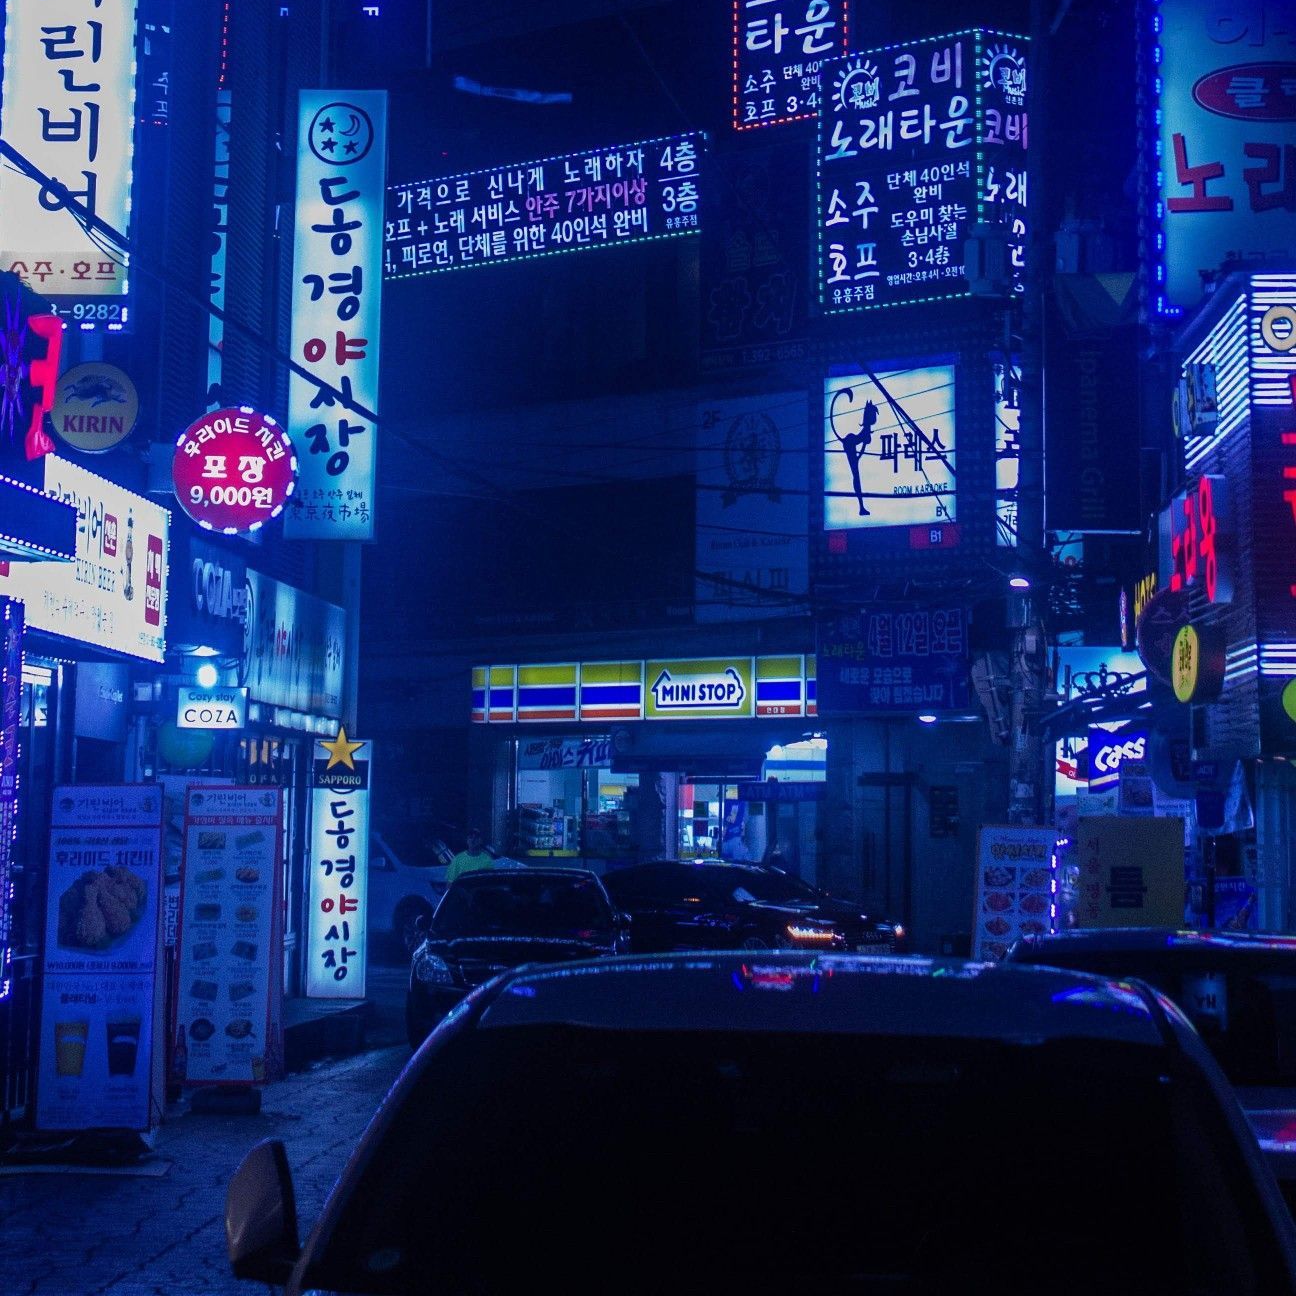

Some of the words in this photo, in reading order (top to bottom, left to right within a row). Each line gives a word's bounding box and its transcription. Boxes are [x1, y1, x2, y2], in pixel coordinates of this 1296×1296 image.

[745, 0, 836, 54] 타운
[744, 69, 776, 93] 소주
[783, 62, 803, 80] 단체
[801, 75, 821, 90] 완비
[888, 41, 962, 101] 코비
[743, 99, 776, 122] 호프
[824, 95, 975, 161] 노래타운
[982, 108, 1028, 150] 코비
[660, 141, 697, 173] 4층
[397, 179, 471, 215] 가격으로
[487, 166, 545, 199] 신나게
[563, 148, 645, 184] 노래하자
[886, 169, 917, 190] 단체
[920, 160, 970, 183] 40인석
[662, 181, 699, 213] 3층
[825, 181, 879, 230] 소주
[913, 184, 942, 204] 완비
[433, 211, 466, 236] 노래
[470, 200, 521, 229] 서비스
[525, 194, 560, 222] 안주
[890, 207, 933, 228] 도우미
[458, 230, 507, 260] 단체를
[513, 222, 547, 252] 위한
[551, 213, 607, 245] 40인석
[613, 206, 648, 237] 완비
[826, 242, 880, 284] 호프
[832, 284, 875, 304] 유흥주점
[302, 176, 370, 477] 동경야시장
[62, 414, 125, 434] KIRIN
[183, 417, 250, 458] 후라이드
[254, 426, 286, 462] 치킨
[201, 455, 267, 483] 포장
[190, 485, 272, 508] 9,000원
[930, 530, 943, 543] B1
[188, 691, 214, 703] Cozy
[216, 691, 236, 703] stay
[661, 682, 737, 703] MINISTOP
[184, 709, 238, 724] COZA
[1094, 737, 1146, 772] Cass
[318, 774, 362, 785] SAPPORO
[55, 850, 110, 867] 후라이드
[320, 800, 359, 982] 동경야시장
[1106, 866, 1148, 908] 틈
